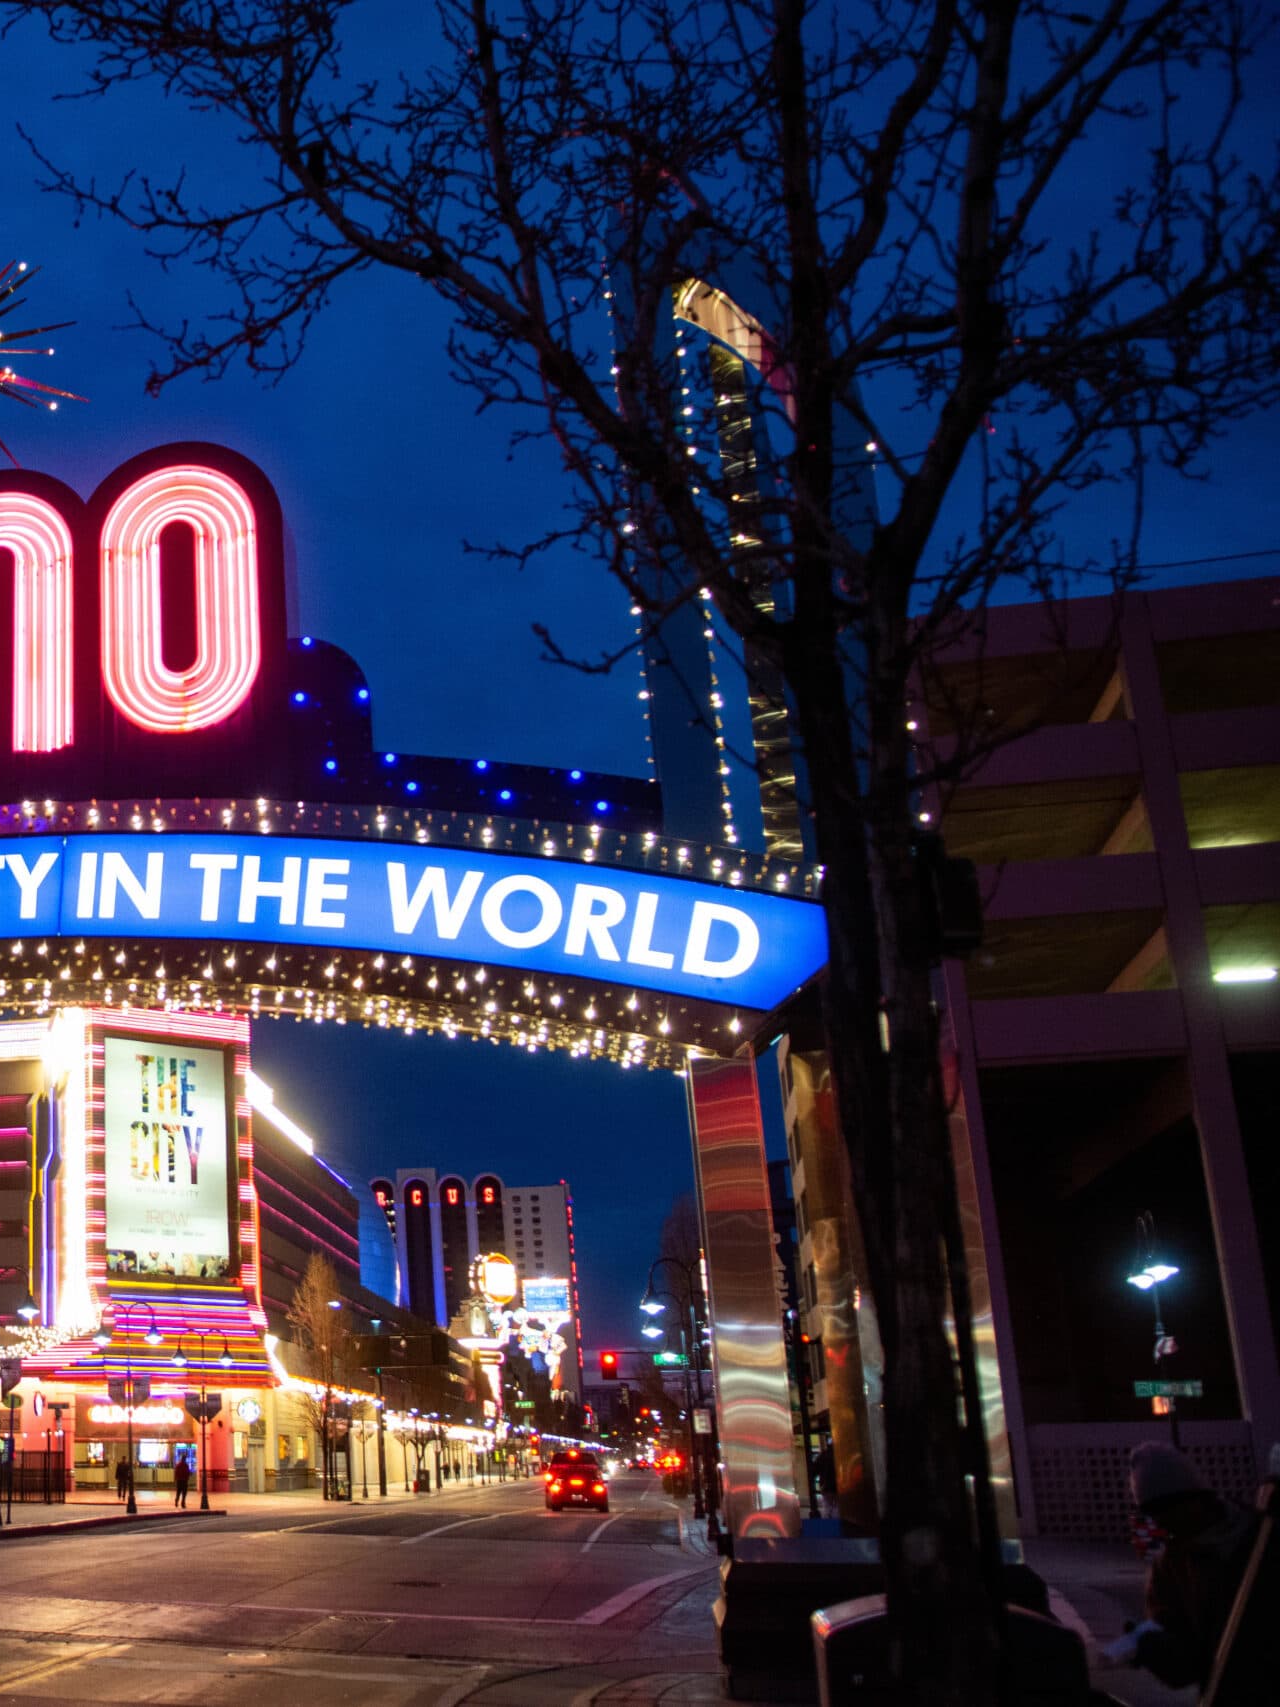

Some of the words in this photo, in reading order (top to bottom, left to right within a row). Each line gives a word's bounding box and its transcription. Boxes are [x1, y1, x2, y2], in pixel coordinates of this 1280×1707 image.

[76, 851, 164, 919] IN
[189, 852, 351, 929] THE
[386, 862, 760, 979] WORLD
[135, 1054, 197, 1118] THE
[129, 1119, 204, 1185] CITY
